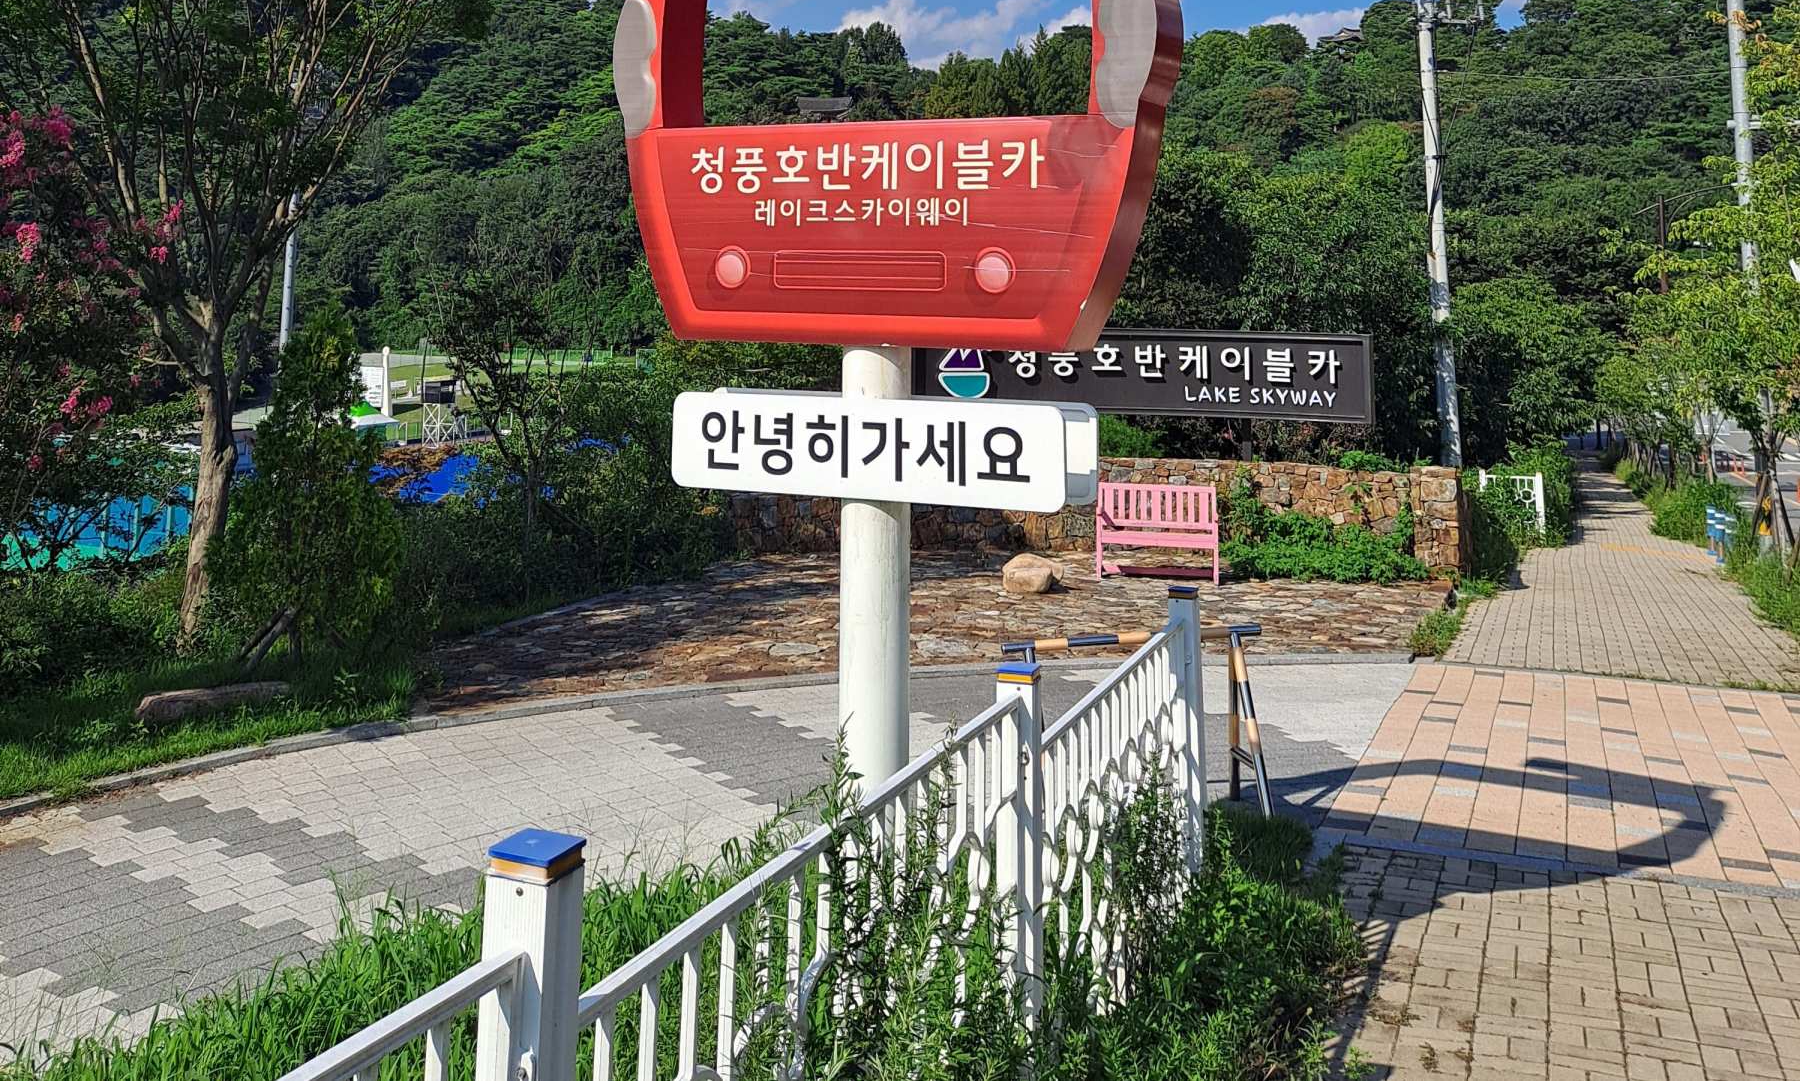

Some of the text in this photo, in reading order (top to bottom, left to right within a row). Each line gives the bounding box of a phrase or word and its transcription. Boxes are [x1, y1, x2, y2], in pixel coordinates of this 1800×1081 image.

[691, 138, 1045, 194] 청풍호반케이블카
[754, 197, 969, 227] 레이크스카이웨이
[1184, 386, 1336, 408] LAKE SKYWAY
[701, 410, 1031, 487] 안녕히가세요
